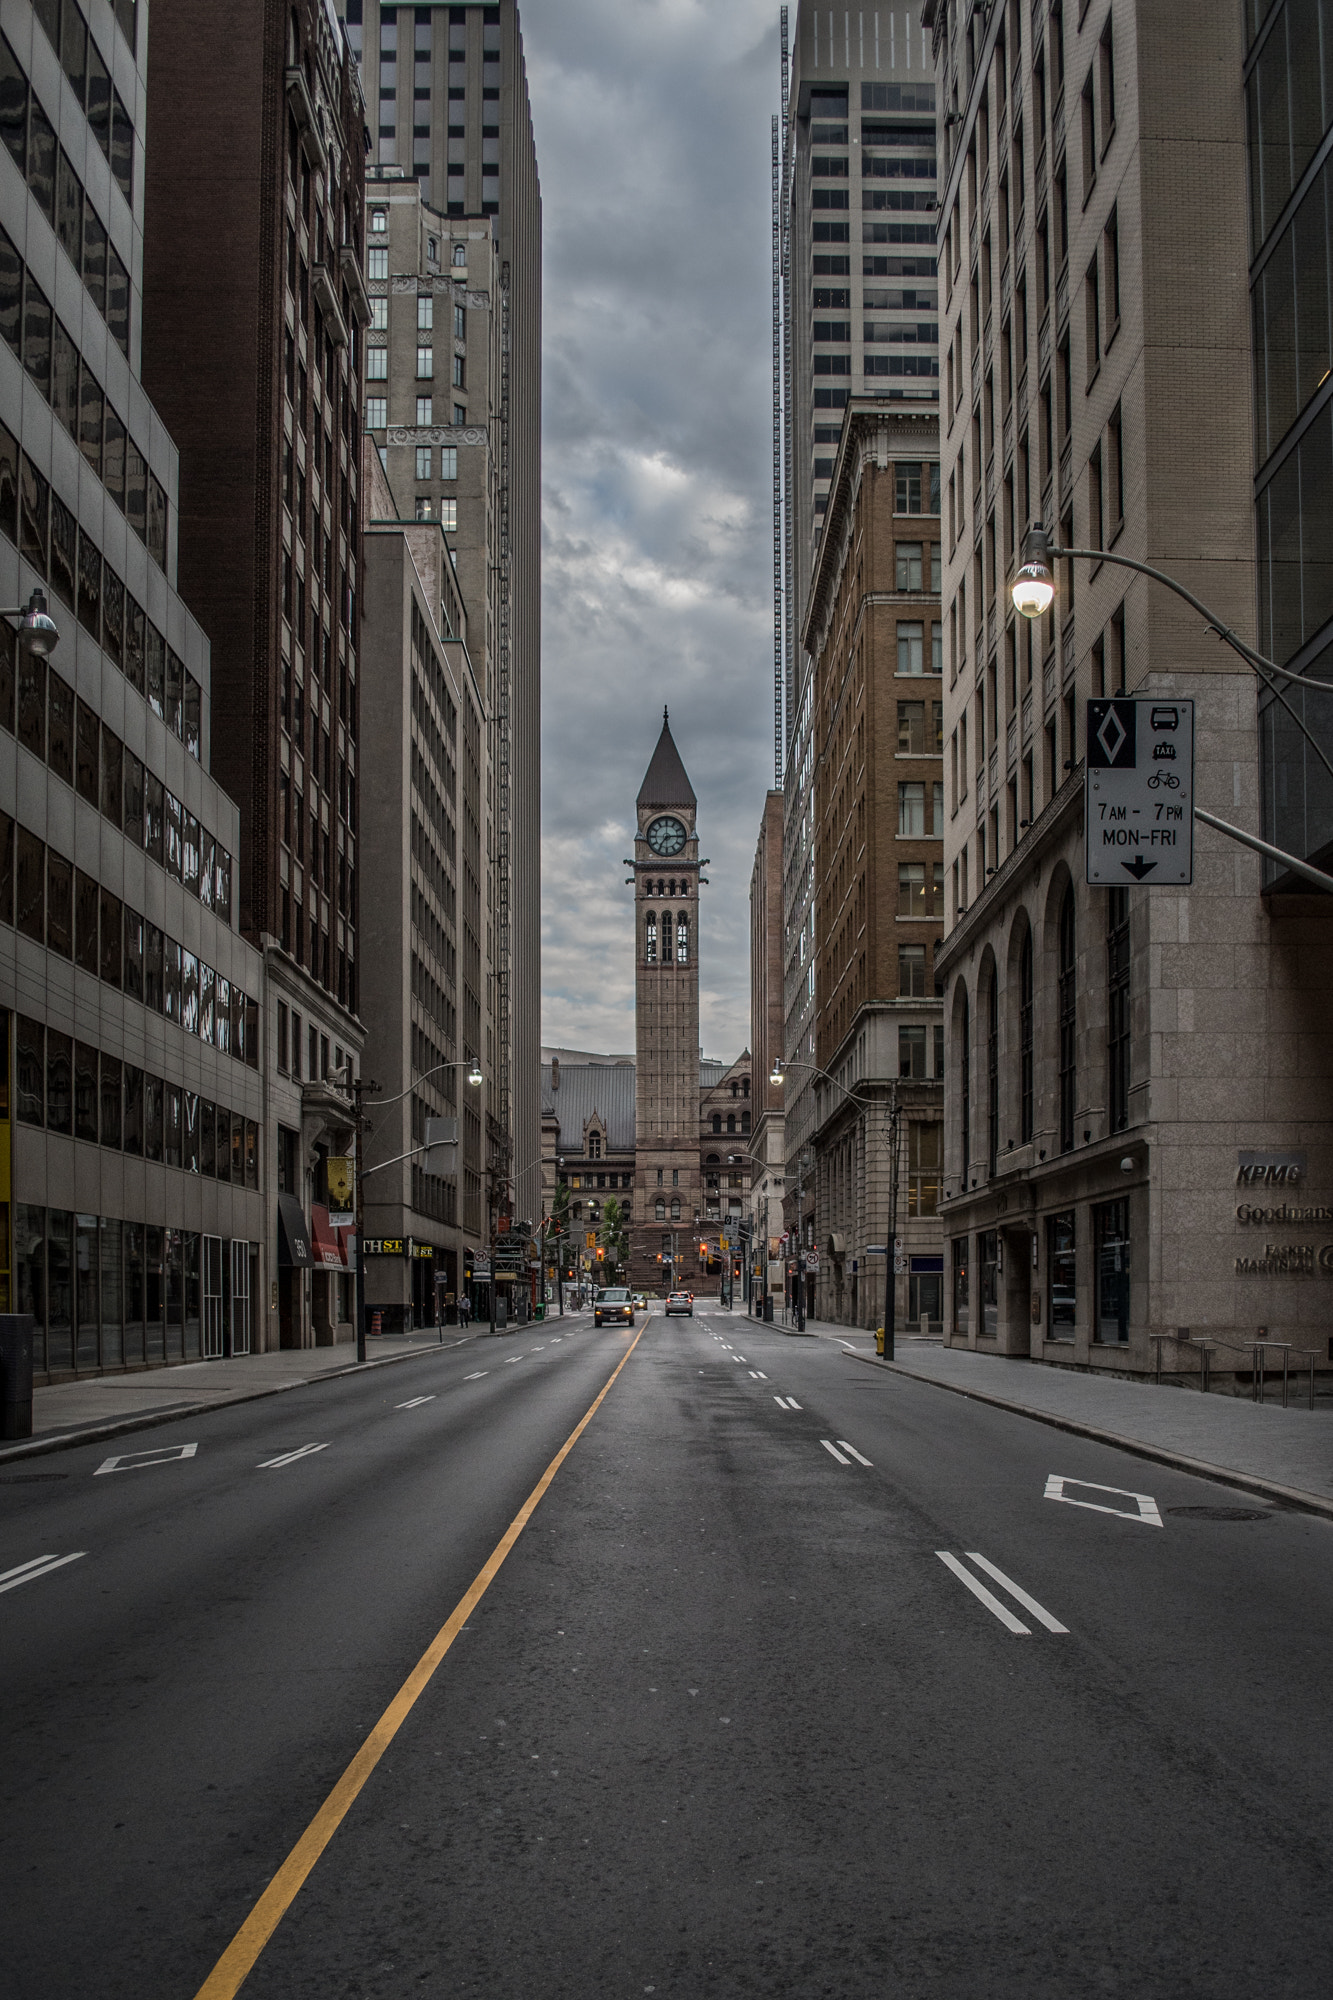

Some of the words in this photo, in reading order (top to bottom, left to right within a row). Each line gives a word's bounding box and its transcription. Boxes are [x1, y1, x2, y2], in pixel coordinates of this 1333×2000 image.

[1155, 746, 1174, 755] TAXI
[1103, 829, 1177, 846] MON-FRI
[1237, 1165, 1300, 1182] KPMG
[1237, 1203, 1333, 1220] Goodmans
[1265, 1244, 1314, 1256] FASKEN
